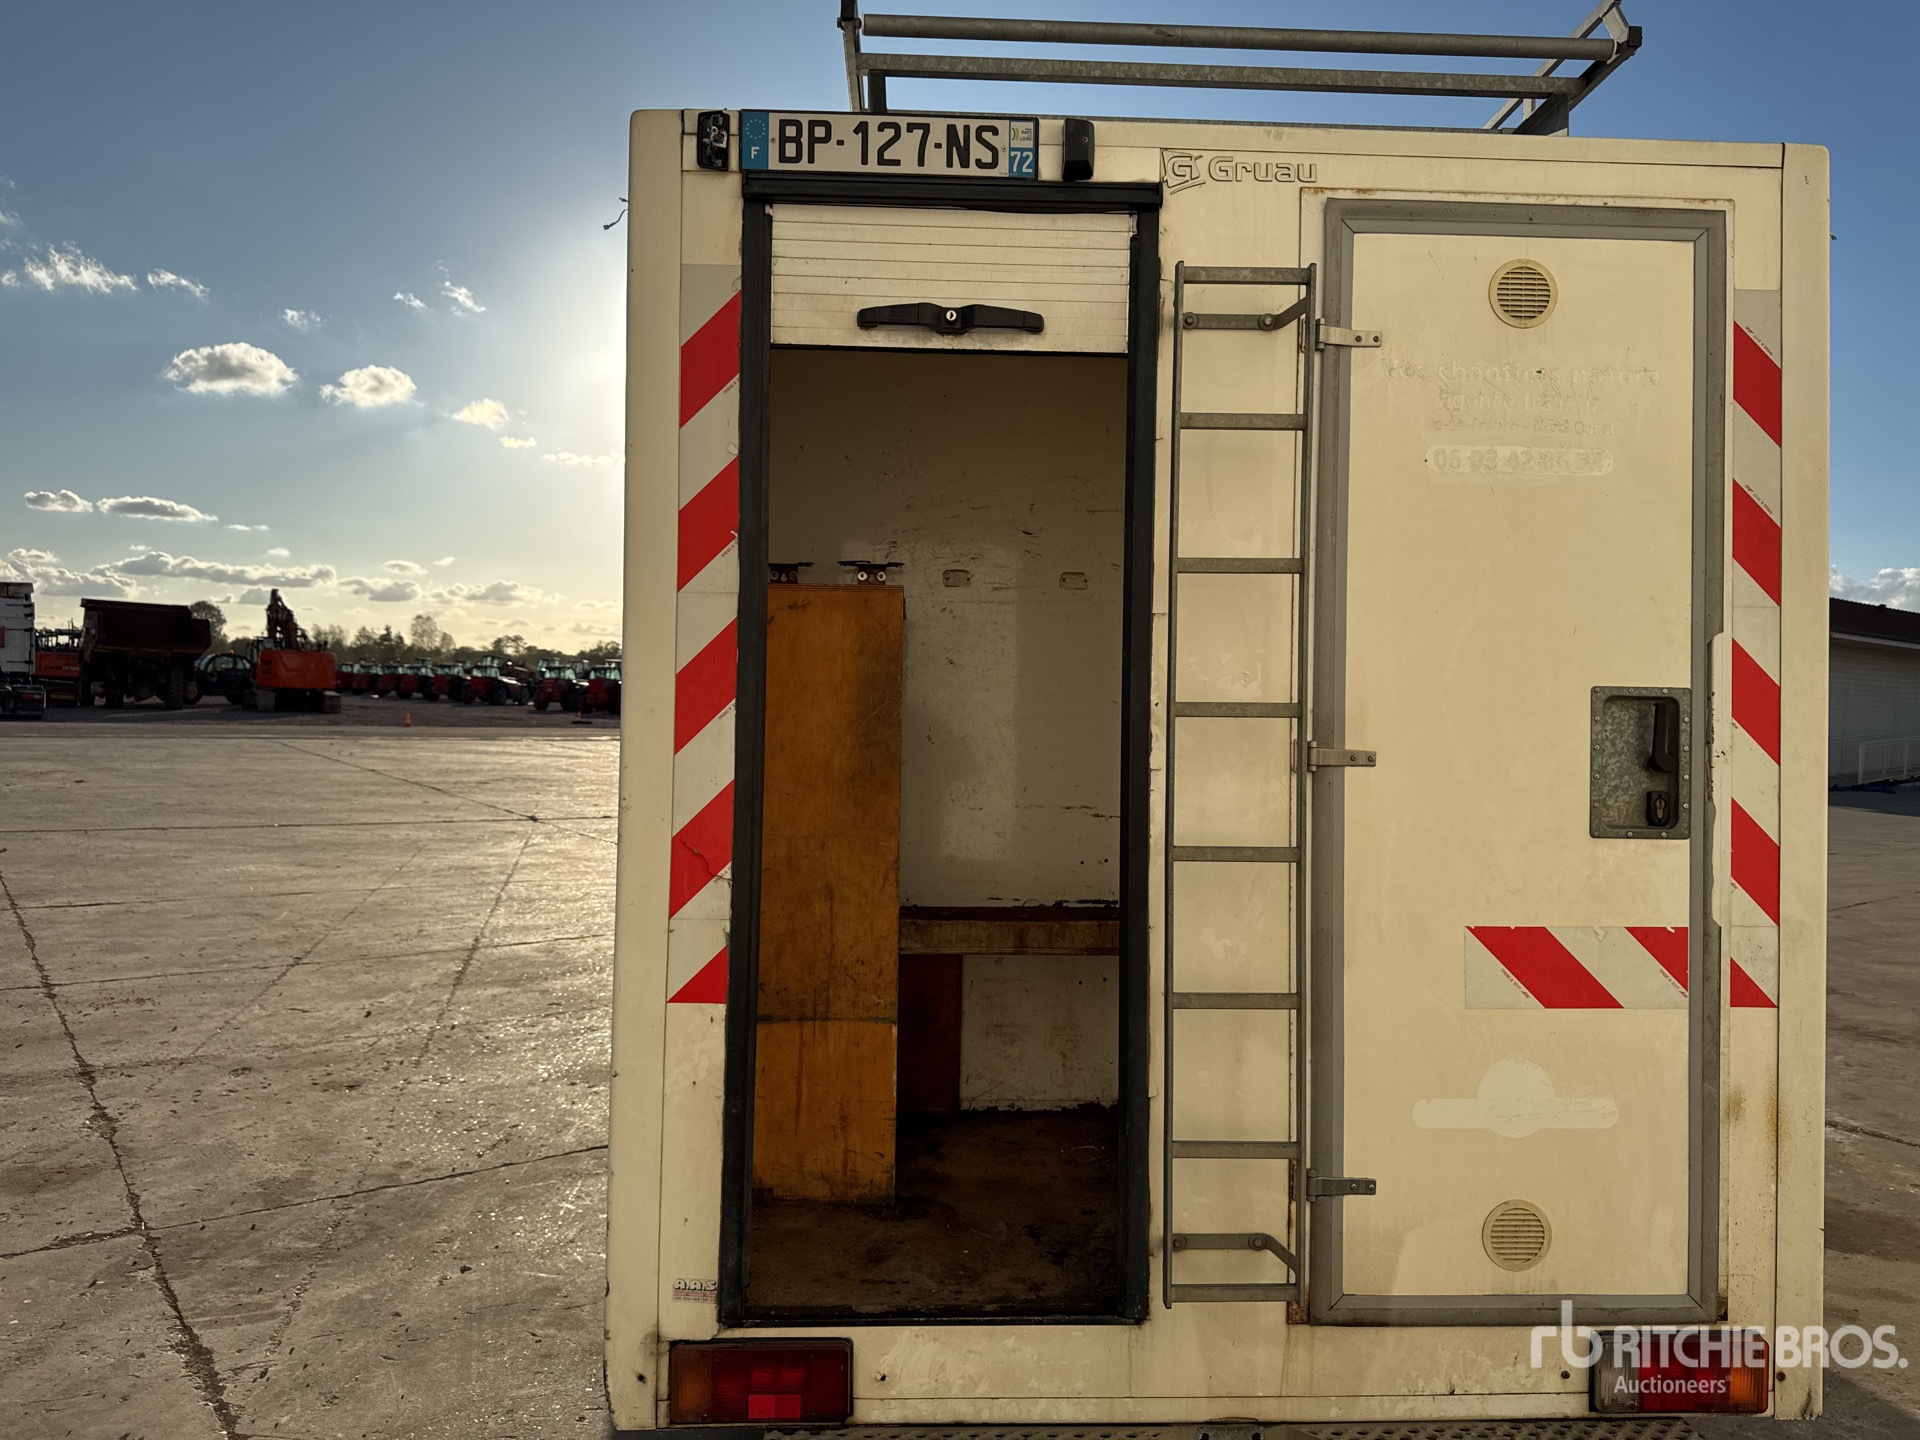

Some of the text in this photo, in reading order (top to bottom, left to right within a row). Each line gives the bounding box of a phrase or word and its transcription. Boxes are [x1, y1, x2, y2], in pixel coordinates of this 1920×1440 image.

[751, 146, 760, 159] F
[779, 119, 999, 169] BP-127-NS
[1010, 151, 1033, 173] 72
[1208, 156, 1317, 183] Gruau
